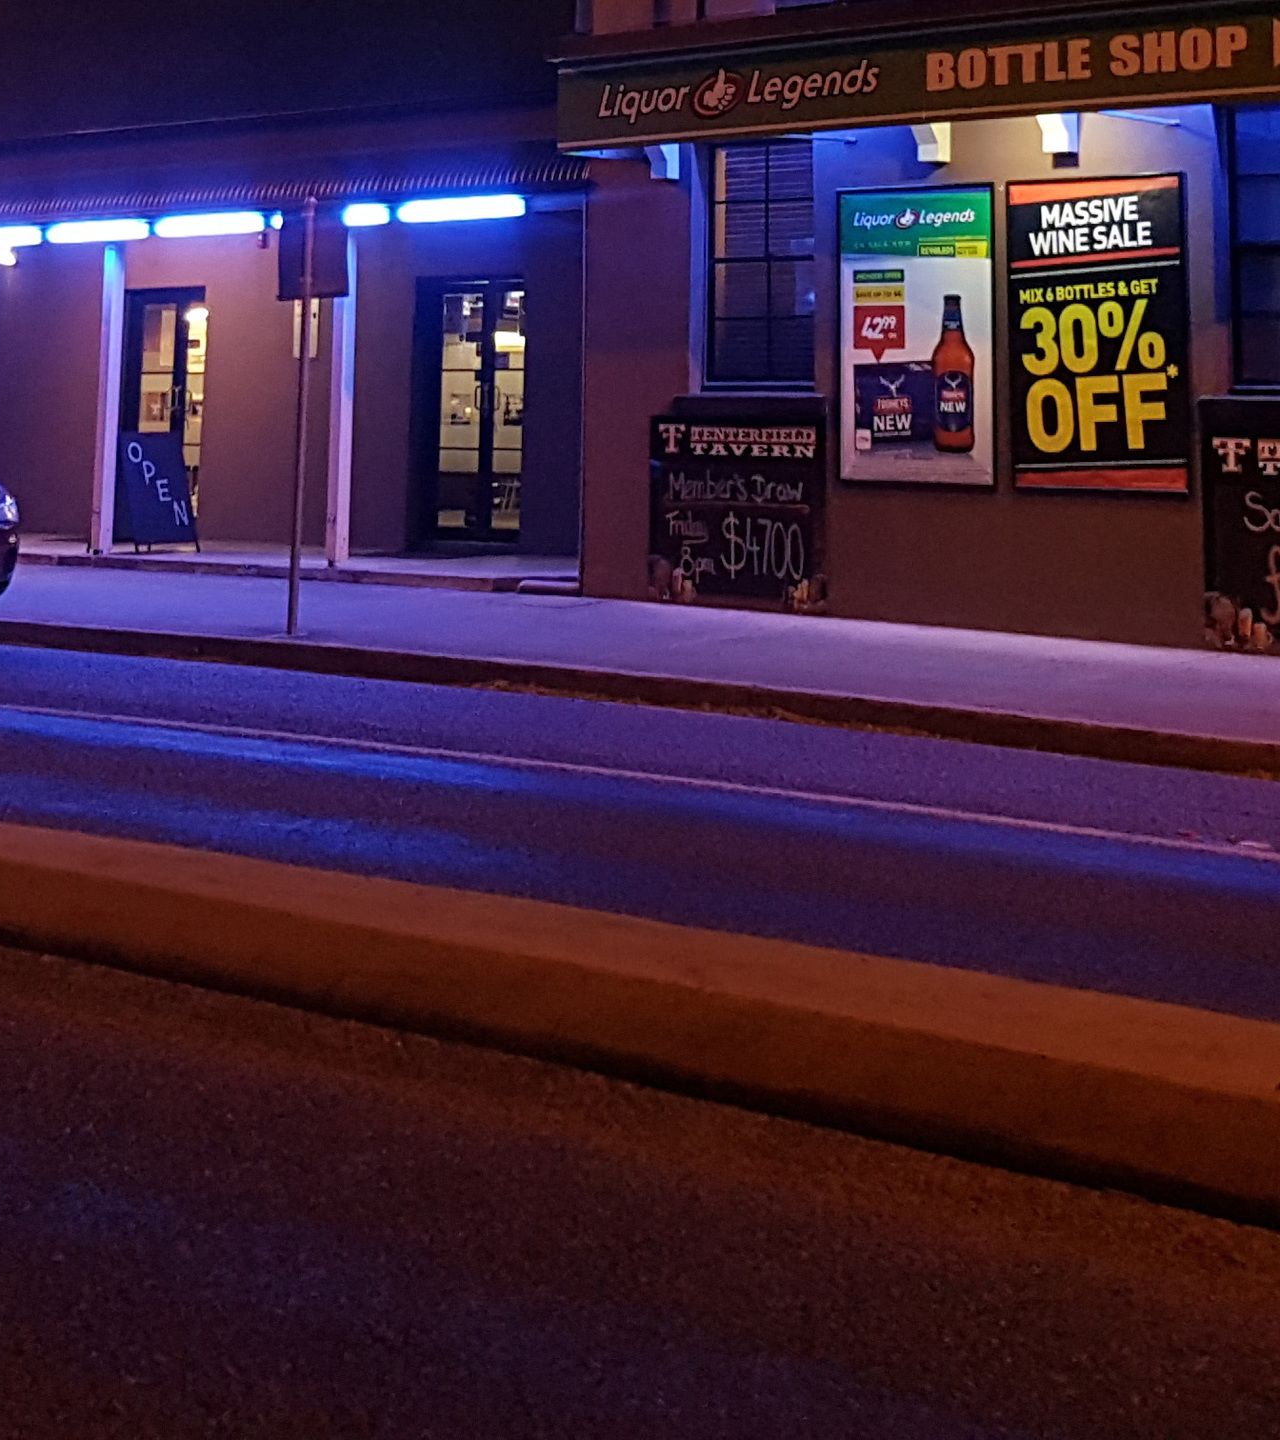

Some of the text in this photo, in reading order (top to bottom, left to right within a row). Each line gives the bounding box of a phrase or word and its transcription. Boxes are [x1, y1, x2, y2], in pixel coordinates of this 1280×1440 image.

[925, 25, 1248, 93] BOTTLE SHOP
[598, 60, 881, 124] Liquor Legends
[853, 208, 976, 230] Liquor Legends
[1040, 195, 1139, 229] MASSIVE
[1029, 221, 1153, 257] WINE SALE
[1019, 278, 1159, 305] MIX 6 BOTTLES & GET
[1020, 298, 1166, 377] 30%
[873, 414, 913, 433] NEW
[939, 401, 967, 413] NEW
[1026, 371, 1169, 453] OFF
[659, 424, 685, 453] T
[690, 443, 816, 458] TAVERN
[691, 427, 816, 444] TENTERFIELD
[1212, 437, 1251, 472] T
[127, 441, 189, 526] OPEN
[751, 474, 803, 503] Draw
[721, 512, 804, 580] $4700
